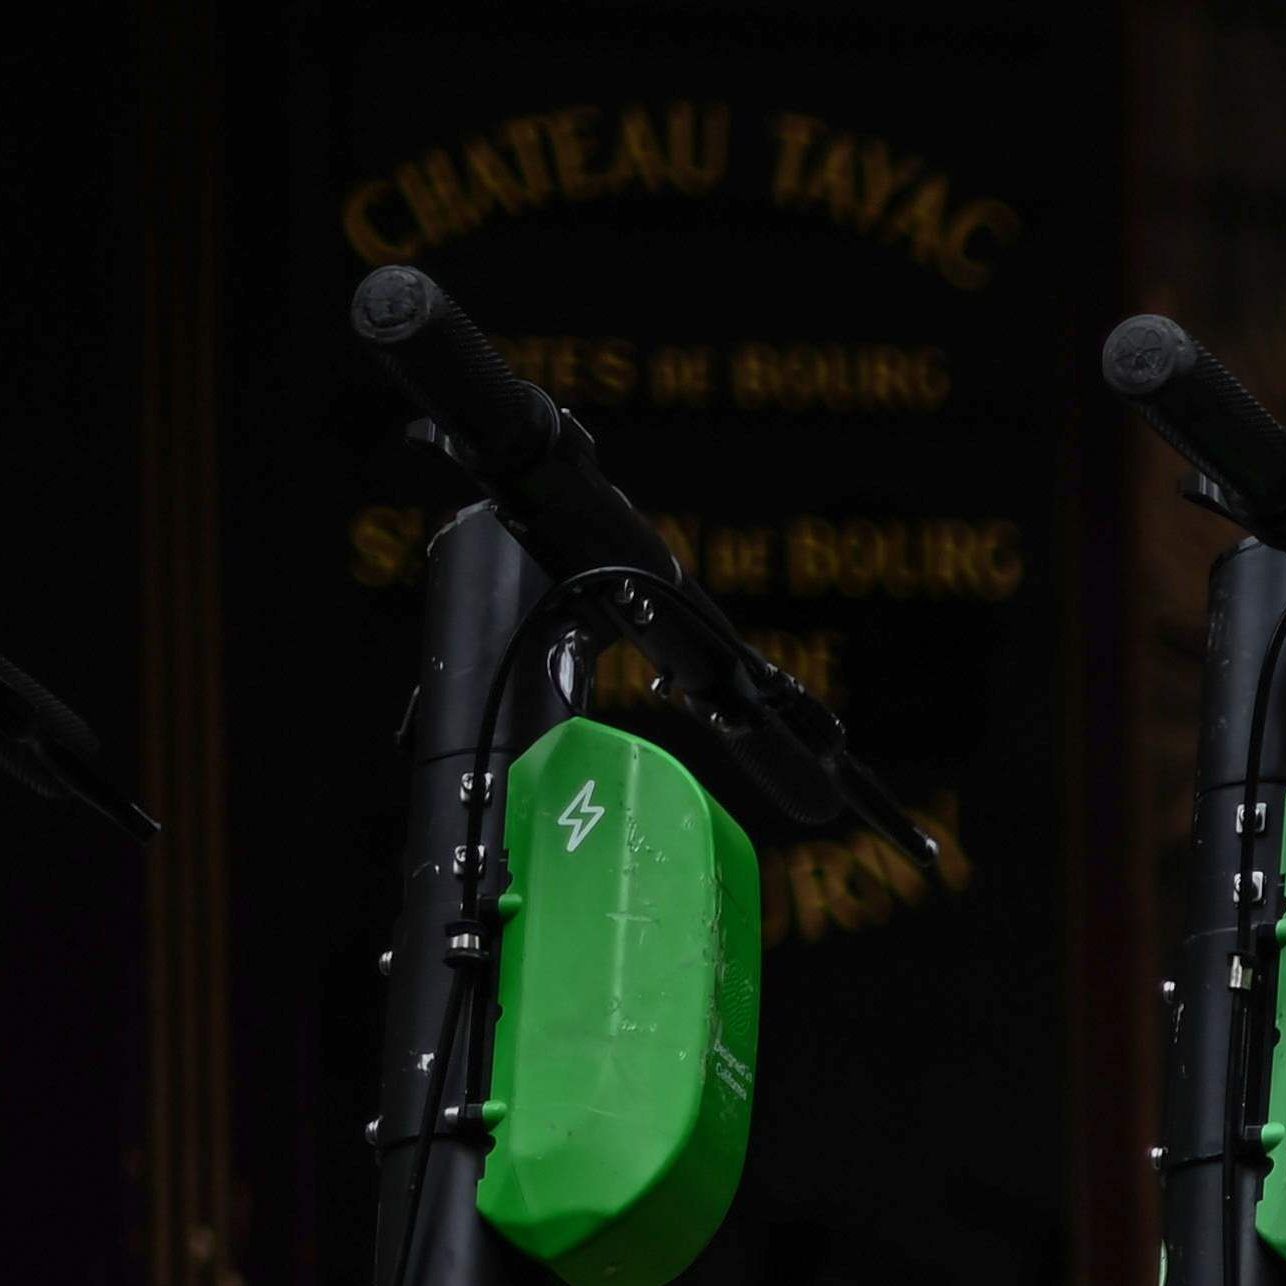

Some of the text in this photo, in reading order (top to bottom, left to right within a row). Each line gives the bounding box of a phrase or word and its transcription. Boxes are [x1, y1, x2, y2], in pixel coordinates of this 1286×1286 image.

[341, 98, 1026, 292] CHATEAU TAYAC
[729, 341, 953, 408] BOURG
[786, 512, 1025, 600] BOURG
